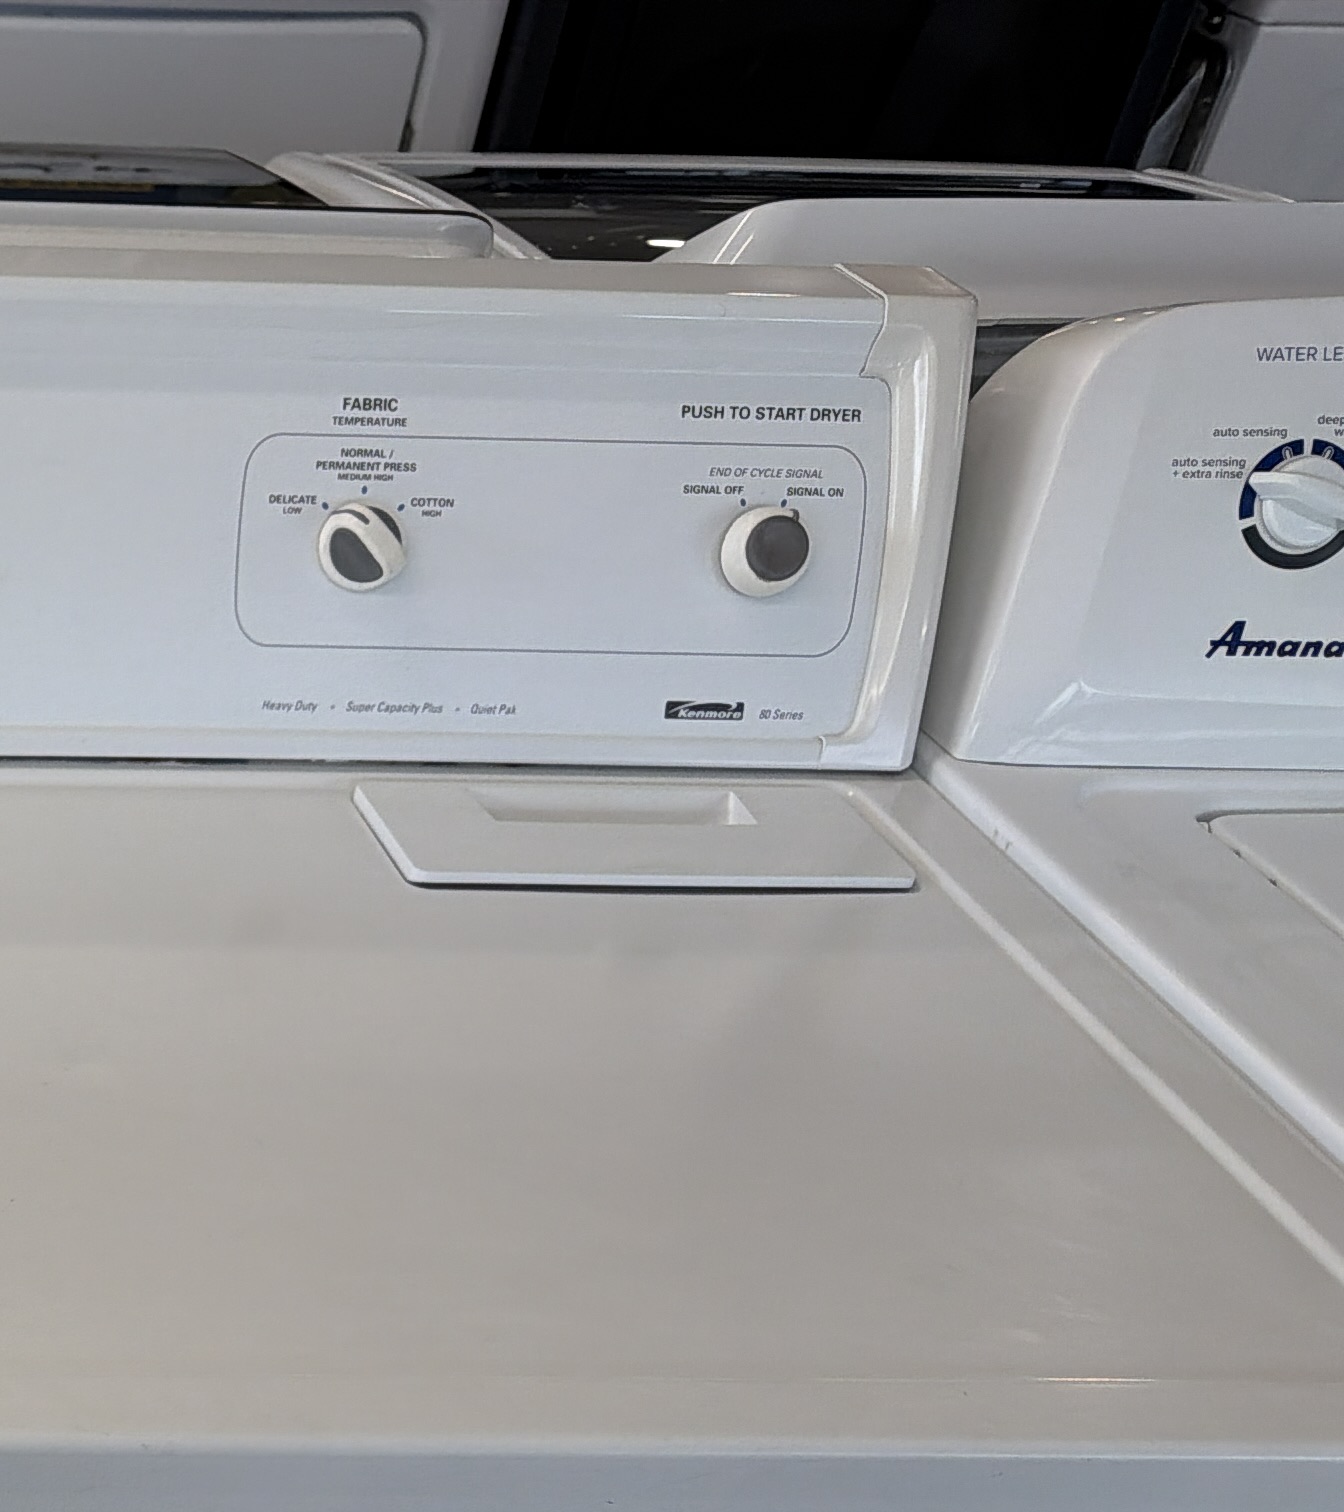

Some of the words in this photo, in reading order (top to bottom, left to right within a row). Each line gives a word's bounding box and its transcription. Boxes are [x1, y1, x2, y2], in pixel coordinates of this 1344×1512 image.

[1256, 347, 1318, 362] WATER
[342, 398, 399, 412] FABRIC
[681, 405, 725, 419] PUSH
[730, 406, 751, 420] TO
[755, 407, 806, 421] START
[810, 407, 862, 423] DRYER
[332, 416, 407, 427] TEMPERATURE
[1213, 428, 1239, 437] auto
[1242, 427, 1288, 439] sensing
[340, 448, 386, 458] NORMAL
[315, 461, 380, 471] PERMANENT
[383, 462, 417, 472] PRESS
[1171, 458, 1198, 467] auto
[1201, 457, 1246, 469] sensing
[337, 473, 372, 481] MEDIUM
[373, 473, 394, 482] HIGH
[709, 467, 732, 477] END
[734, 468, 748, 477] OF
[750, 468, 782, 478] CYCLE
[785, 469, 823, 479] SIGNAL
[1182, 470, 1212, 478] extra
[1214, 469, 1243, 478] rinse
[683, 485, 722, 495] SIGNAL
[724, 485, 744, 495] OFF
[787, 487, 825, 497] SIGNAL
[828, 487, 844, 497] ON
[269, 494, 317, 505] DELICATE
[410, 497, 454, 508] COTTON
[1205, 620, 1344, 659] Amana
[262, 700, 293, 712] Heavy
[294, 700, 318, 713] Duty
[346, 701, 375, 713] Super
[377, 701, 419, 715] Capacity
[421, 702, 443, 714] Plus
[470, 703, 497, 715] Quiet
[498, 704, 516, 715] Pak
[678, 709, 742, 720] Kenmore
[759, 709, 771, 720] 80
[772, 709, 804, 720] Series
